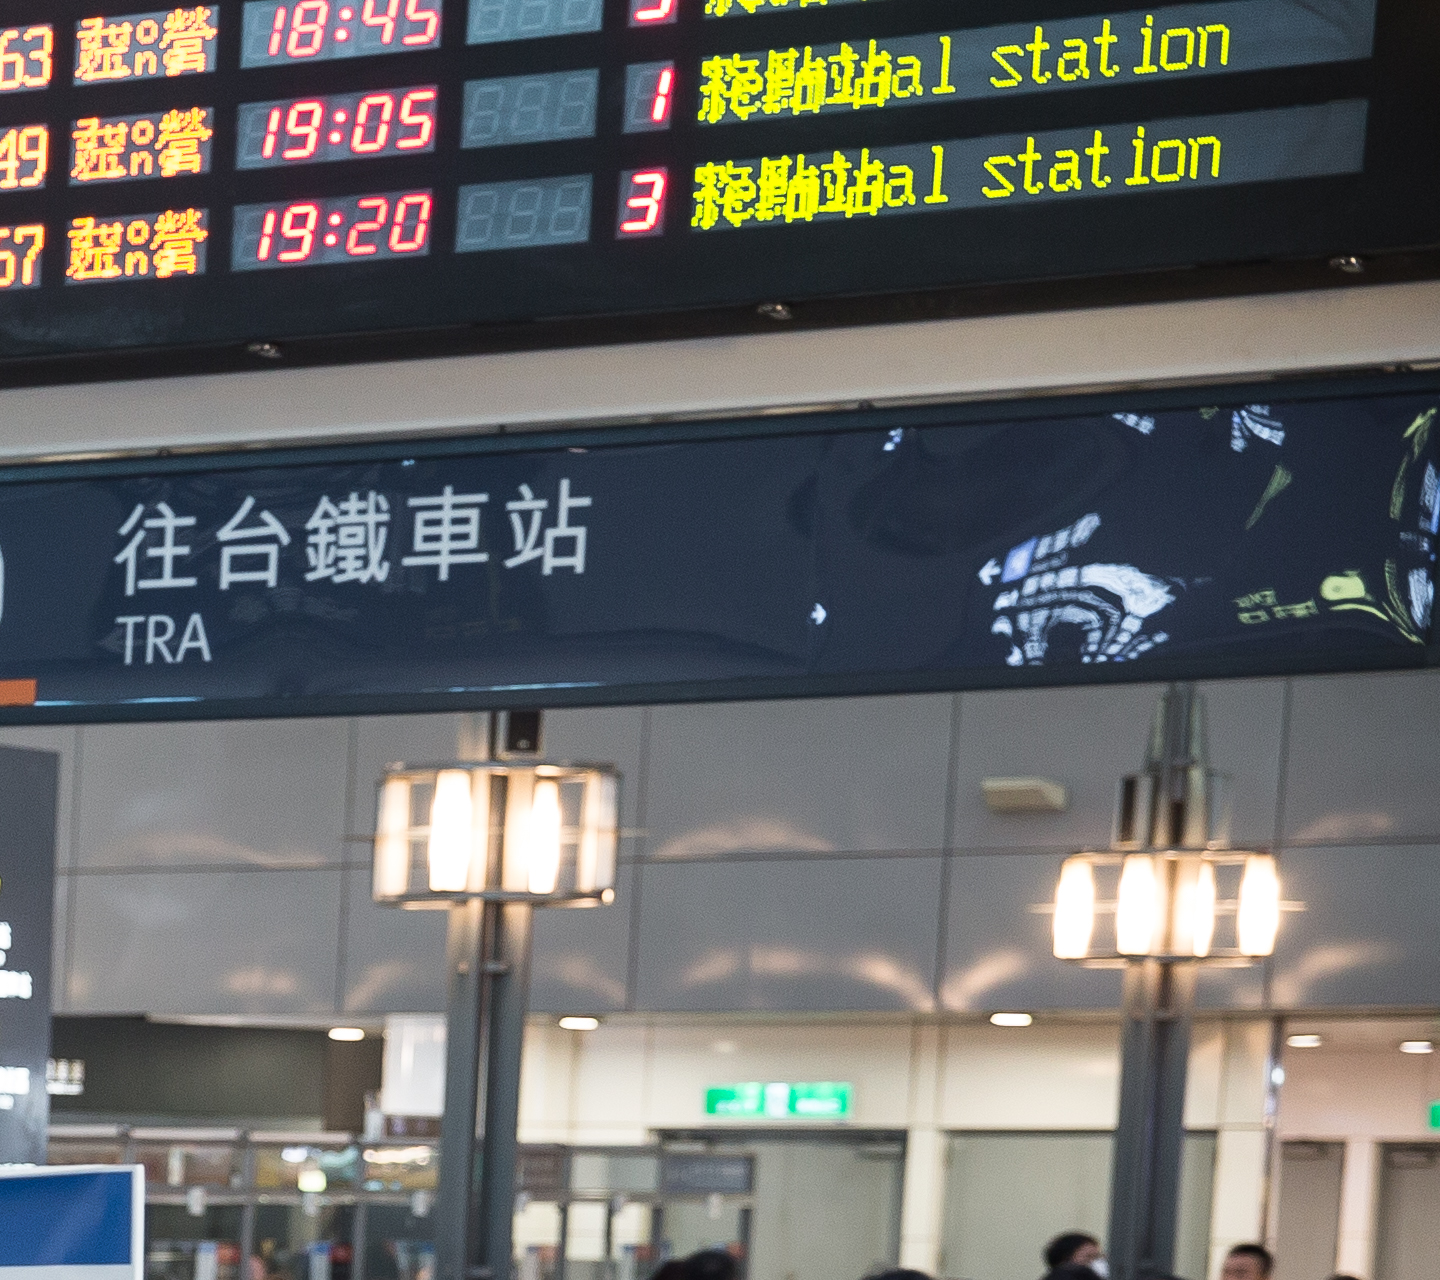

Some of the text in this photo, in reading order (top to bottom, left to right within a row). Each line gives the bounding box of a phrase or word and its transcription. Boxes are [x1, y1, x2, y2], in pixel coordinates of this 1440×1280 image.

[989, 13, 1231, 89] station
[261, 90, 438, 160] 19:05
[651, 69, 674, 122] 1
[982, 125, 1222, 199] station
[256, 193, 433, 262] 19:20
[619, 171, 667, 233] 3
[113, 478, 593, 596] 往台鐵車站
[116, 612, 213, 666] TRA
